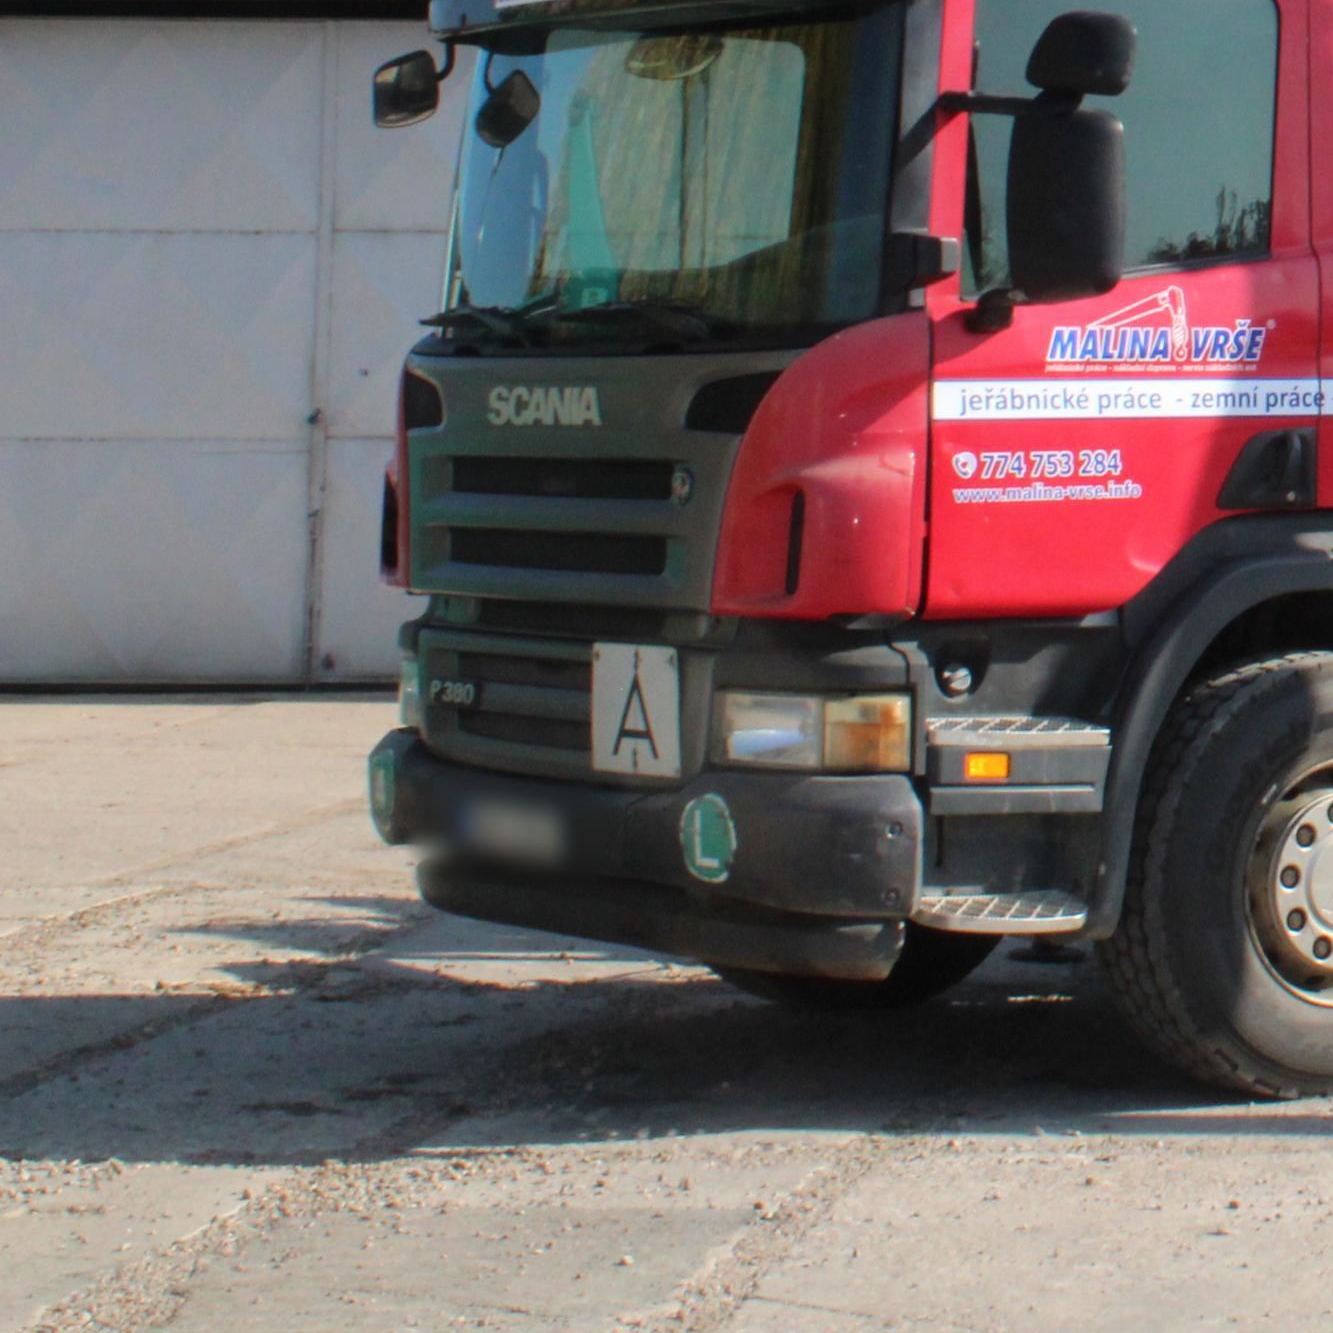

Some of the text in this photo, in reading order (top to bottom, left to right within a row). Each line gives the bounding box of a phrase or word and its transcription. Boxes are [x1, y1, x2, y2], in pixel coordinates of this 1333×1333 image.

[1046, 319, 1266, 361] MALINA VRŠE
[488, 386, 602, 426] SCANIA
[960, 387, 1090, 415] jeřábnické
[1098, 387, 1162, 414] práce
[1190, 386, 1258, 409] zemní
[1265, 386, 1325, 412] práce
[980, 450, 1122, 479] 774 753 284
[953, 480, 1142, 504] www.malina-vrse.info
[430, 679, 475, 705] P 380
[613, 667, 660, 760] A
[694, 809, 720, 868] L
